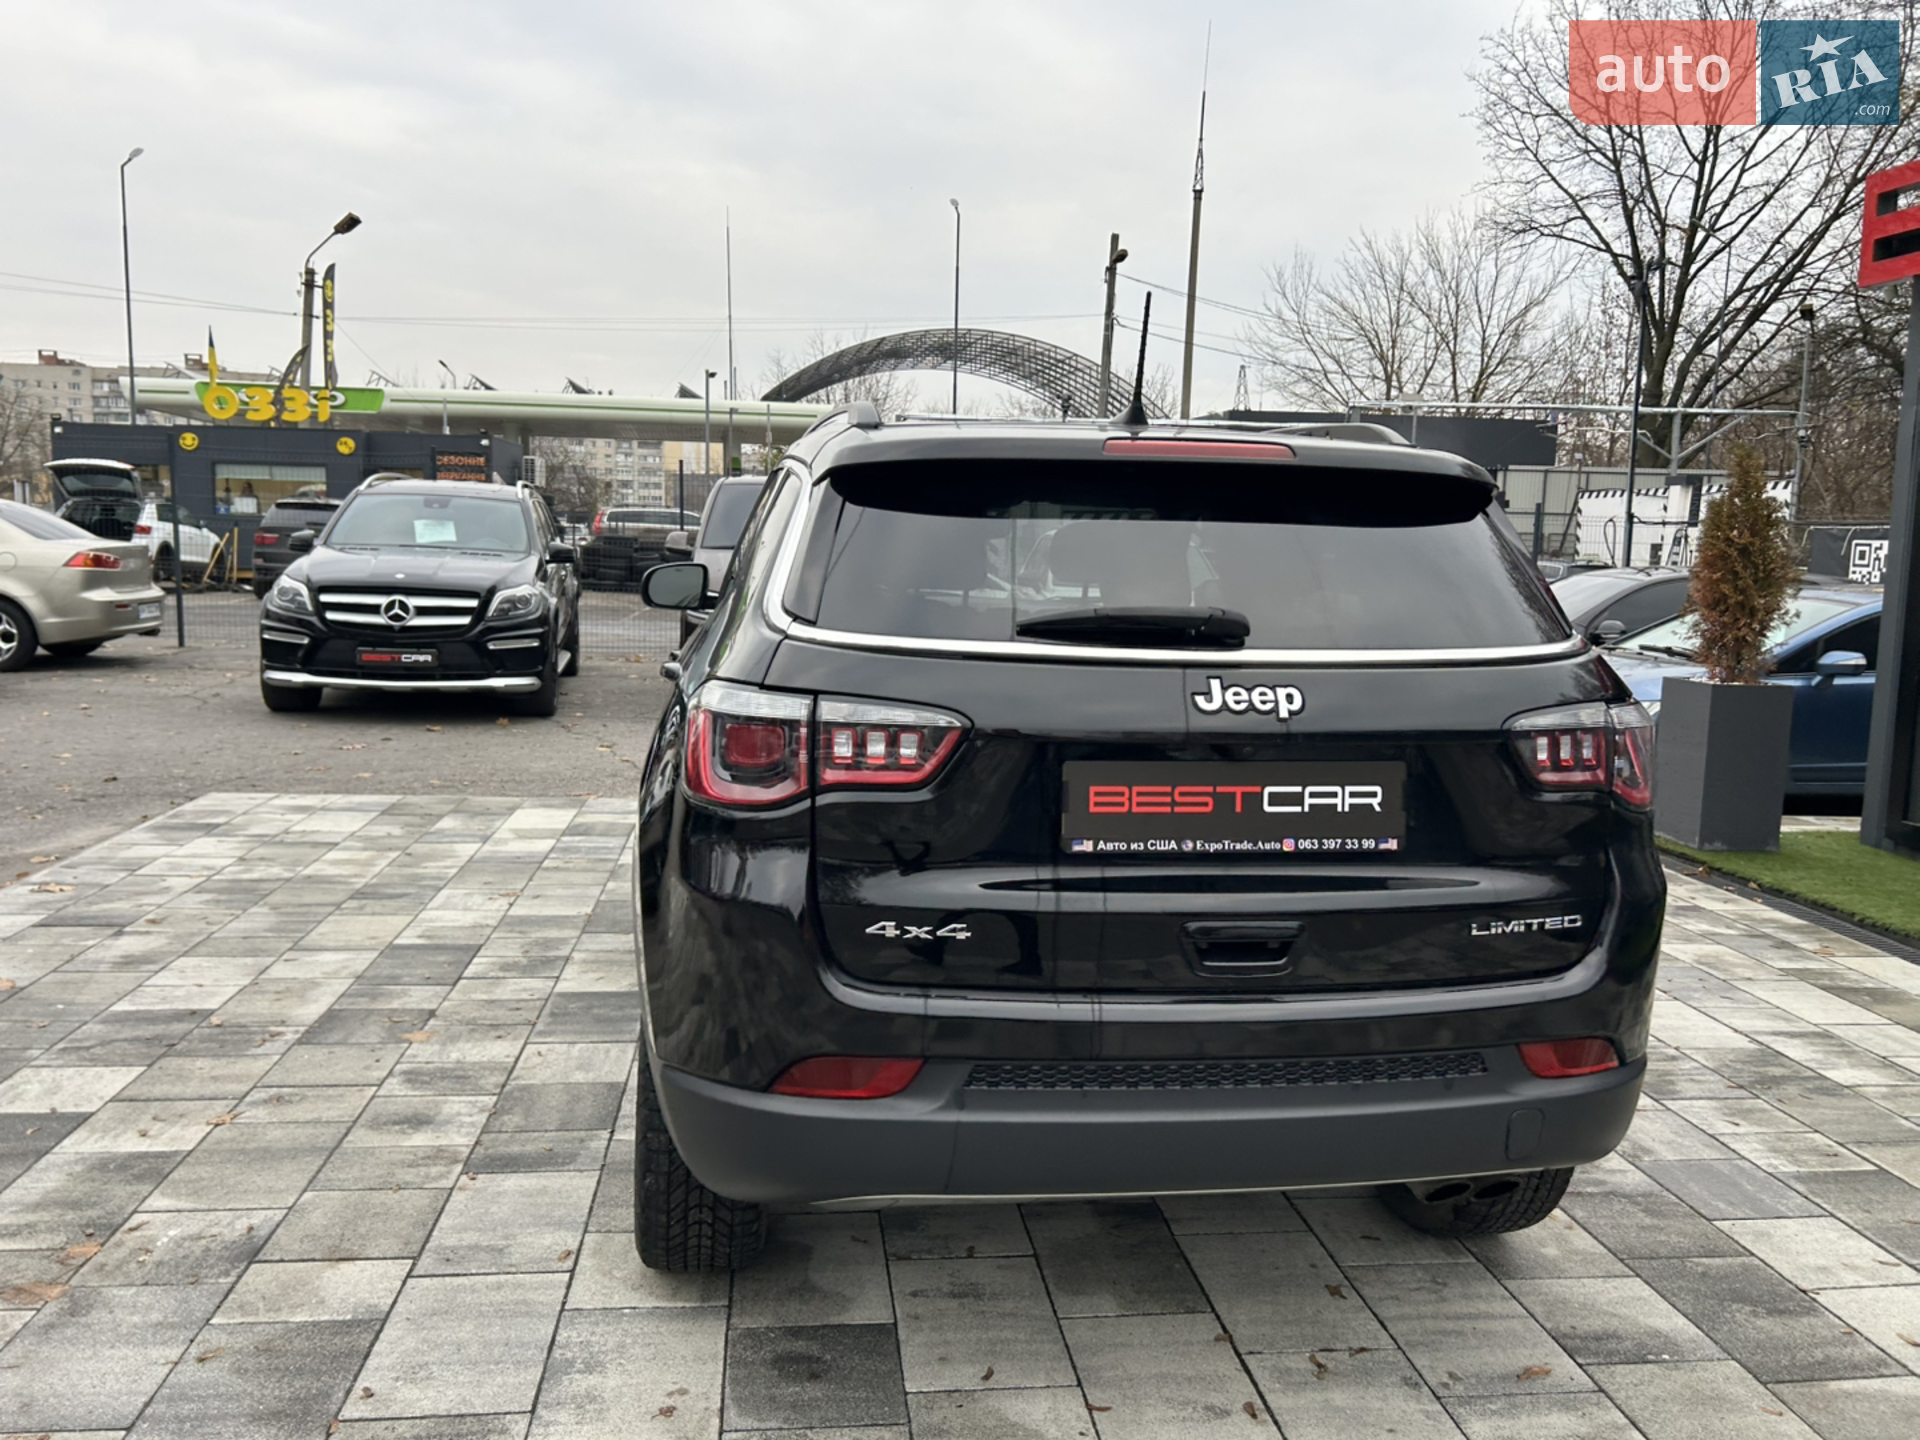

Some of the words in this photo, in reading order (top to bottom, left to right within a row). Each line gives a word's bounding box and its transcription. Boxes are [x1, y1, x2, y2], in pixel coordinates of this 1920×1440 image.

[1192, 676, 1304, 721] Jeep
[1088, 785, 1383, 814] BESTCAR
[1096, 839, 1128, 851] Авто
[1130, 841, 1145, 851] из
[1147, 839, 1178, 851] США
[1196, 839, 1281, 853] ExpoTrade.Auto
[1297, 838, 1319, 850] 063
[1321, 838, 1342, 850] 397
[1344, 838, 1359, 850] 33
[1361, 838, 1376, 850] 99
[864, 920, 973, 940] 4x4
[1470, 914, 1583, 936] LIMITED
